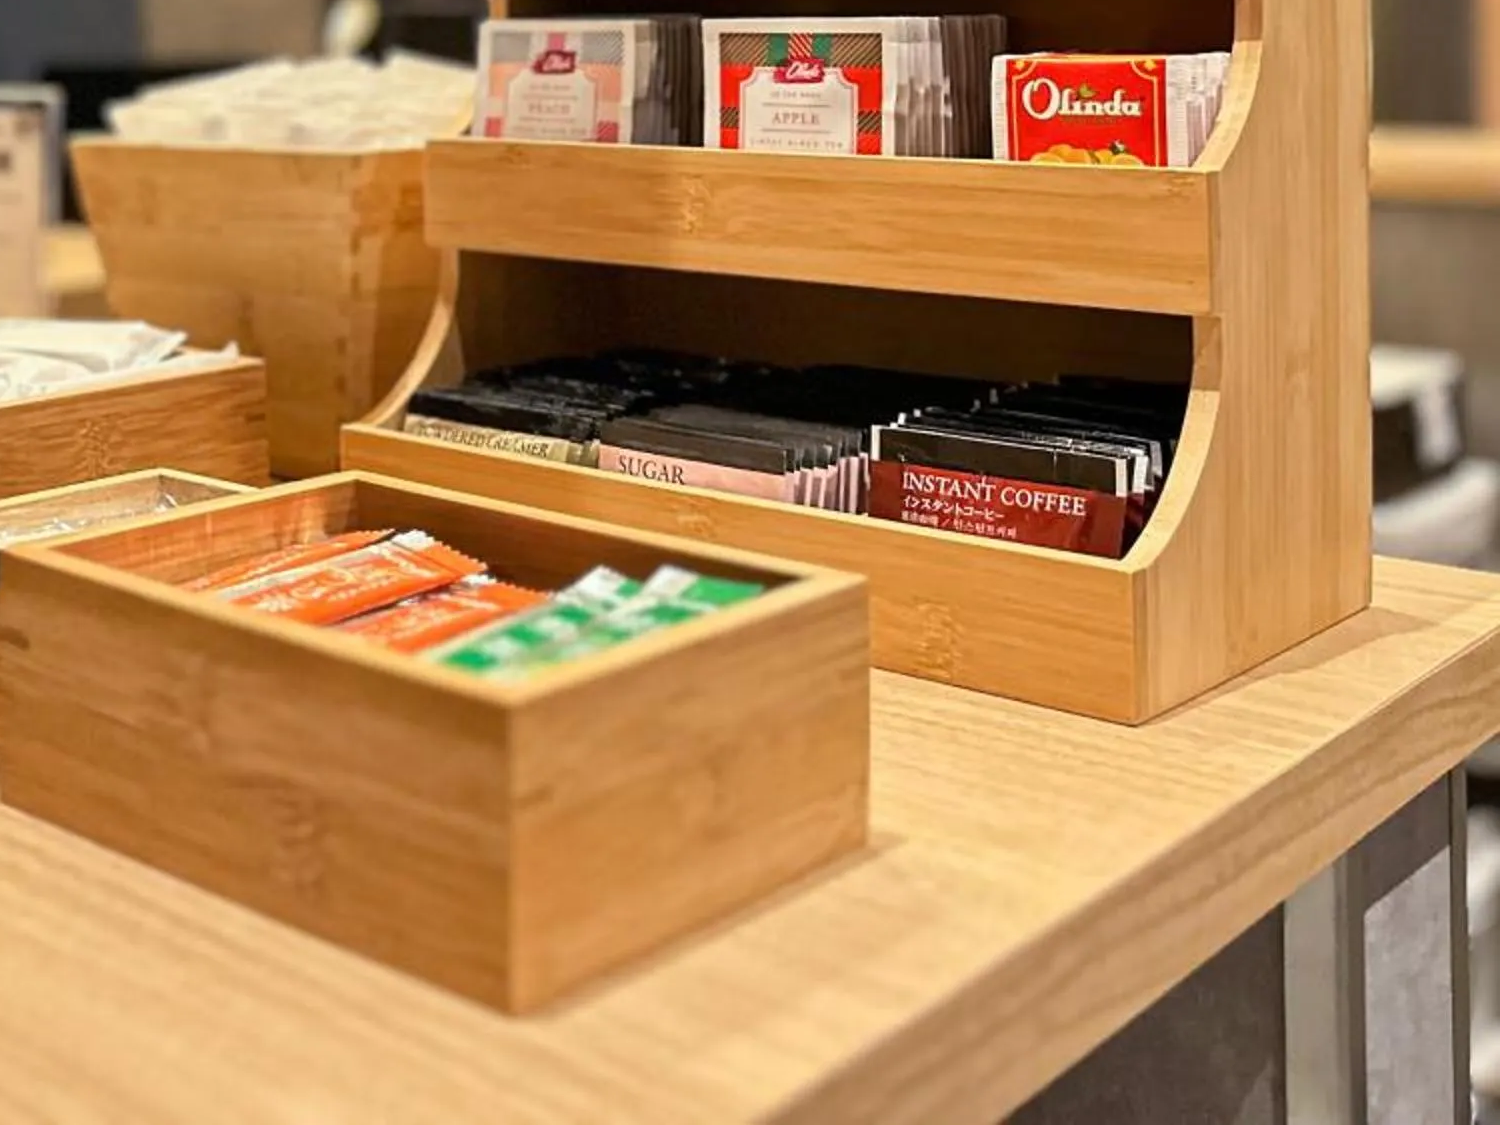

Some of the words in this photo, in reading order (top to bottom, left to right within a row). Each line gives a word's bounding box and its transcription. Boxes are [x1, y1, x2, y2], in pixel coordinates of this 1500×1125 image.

[1021, 77, 1142, 121] Olinda
[771, 112, 821, 125] APPLE
[618, 454, 686, 486] SUGAR
[902, 471, 997, 502] INSTANT
[1000, 486, 1088, 517] COFFEE
[903, 495, 1005, 522] インスタントコーヒー
